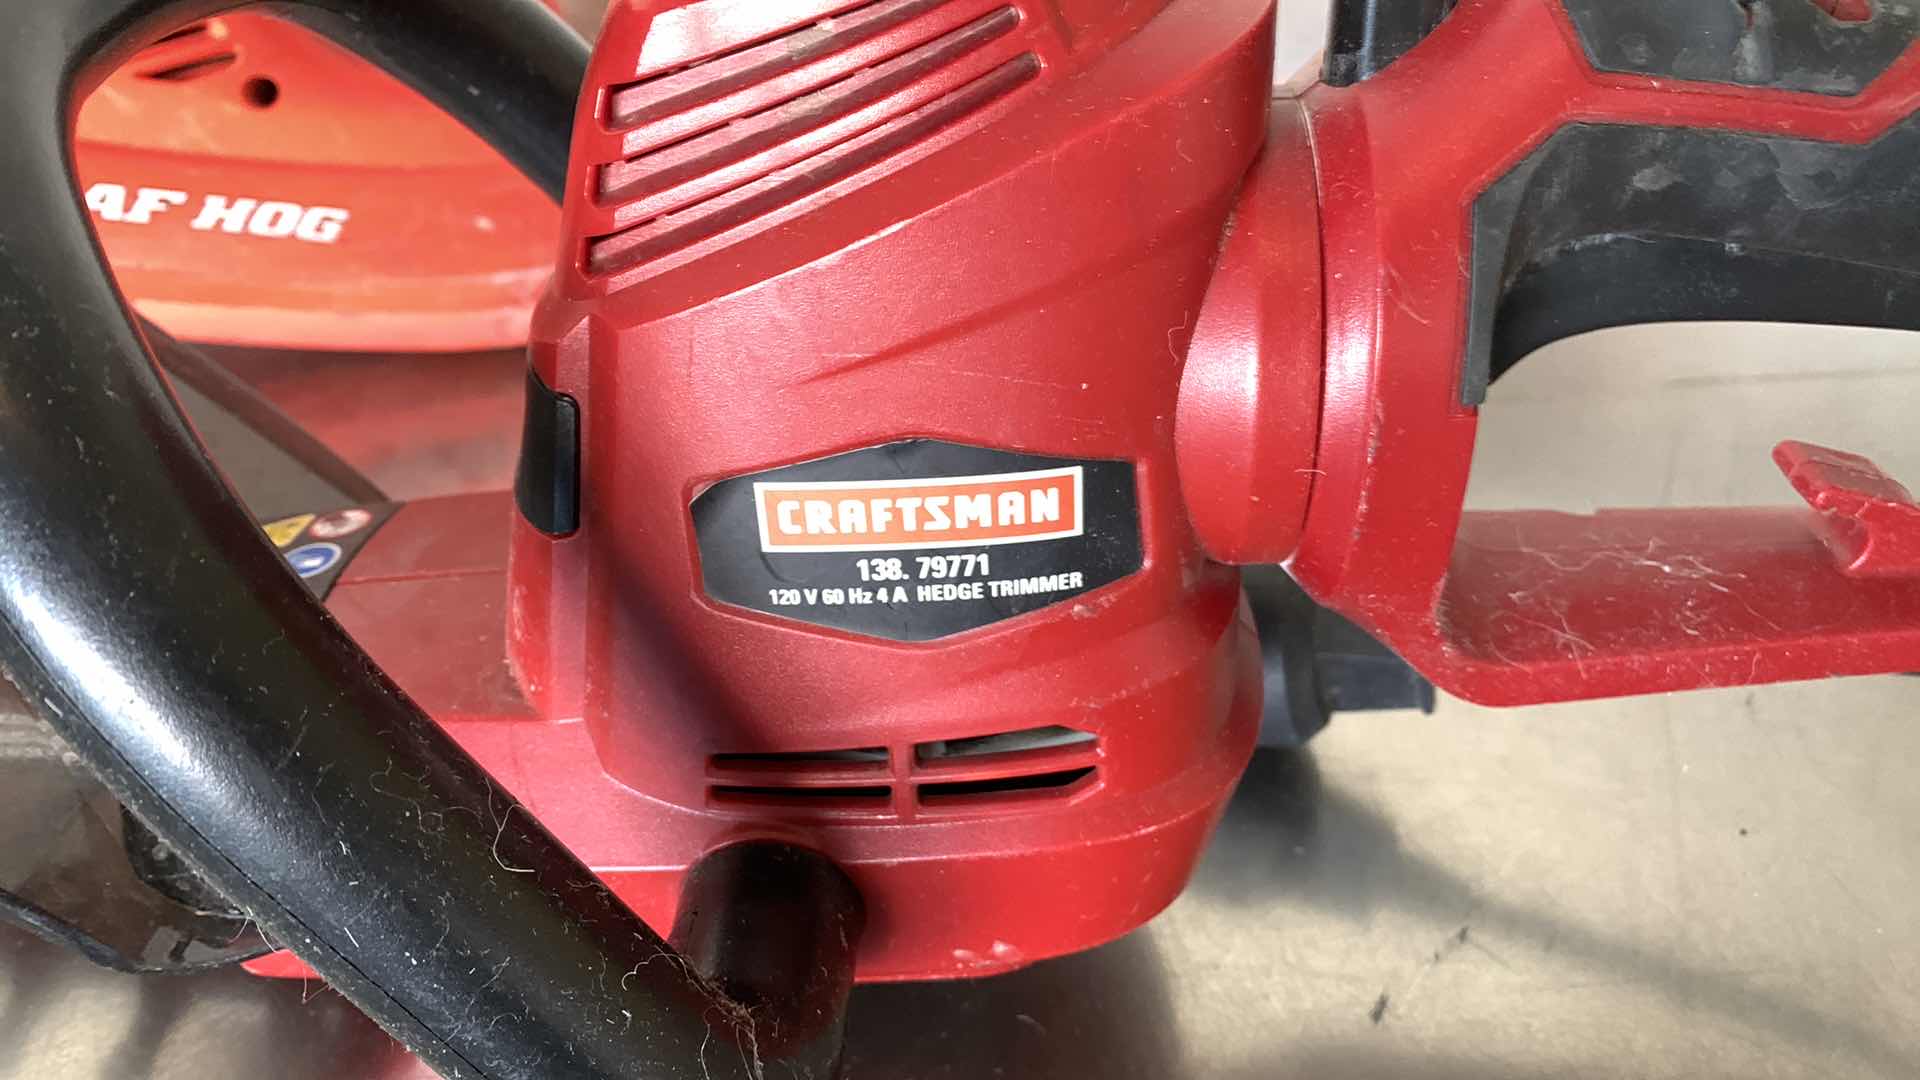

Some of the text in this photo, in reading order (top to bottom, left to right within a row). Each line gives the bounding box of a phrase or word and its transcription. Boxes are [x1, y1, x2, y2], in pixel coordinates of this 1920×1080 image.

[190, 194, 350, 243] HOG
[776, 487, 1061, 535] CRAFTSMAN
[856, 553, 990, 582] 138. 79771
[768, 571, 1084, 606] 120 V 60 Hz 4 A HEDGE TRIMMER
